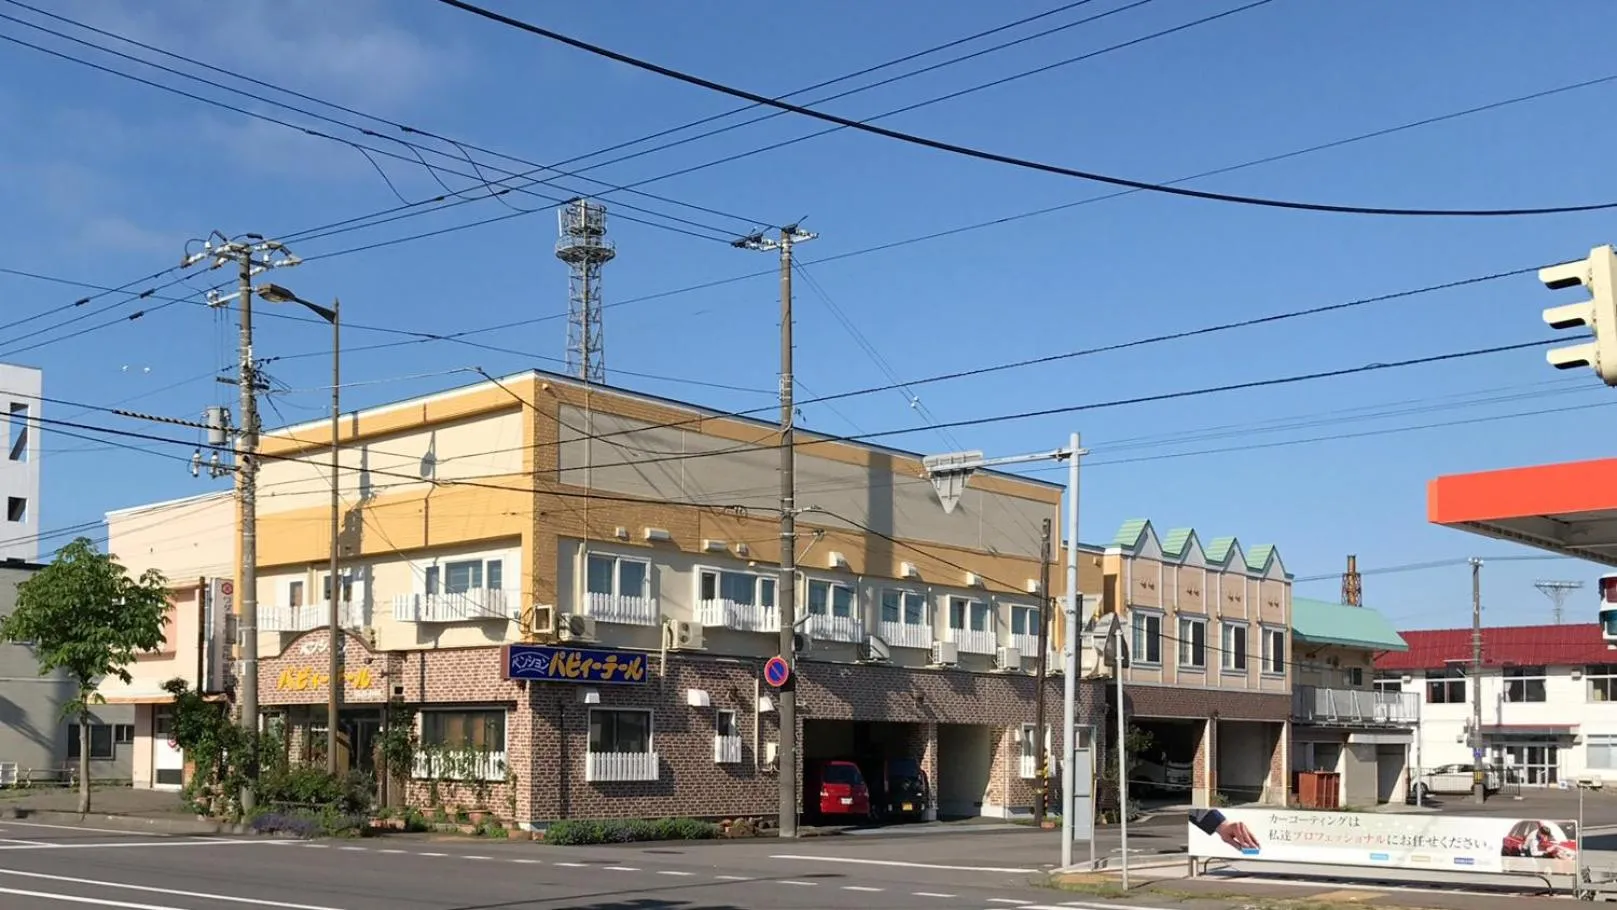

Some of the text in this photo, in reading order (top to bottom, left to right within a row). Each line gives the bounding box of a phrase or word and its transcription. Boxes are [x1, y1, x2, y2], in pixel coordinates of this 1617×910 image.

[300, 640, 346, 657] ペンシン
[511, 655, 549, 669] ペンション
[1270, 813, 1361, 827] カーコーティングは
